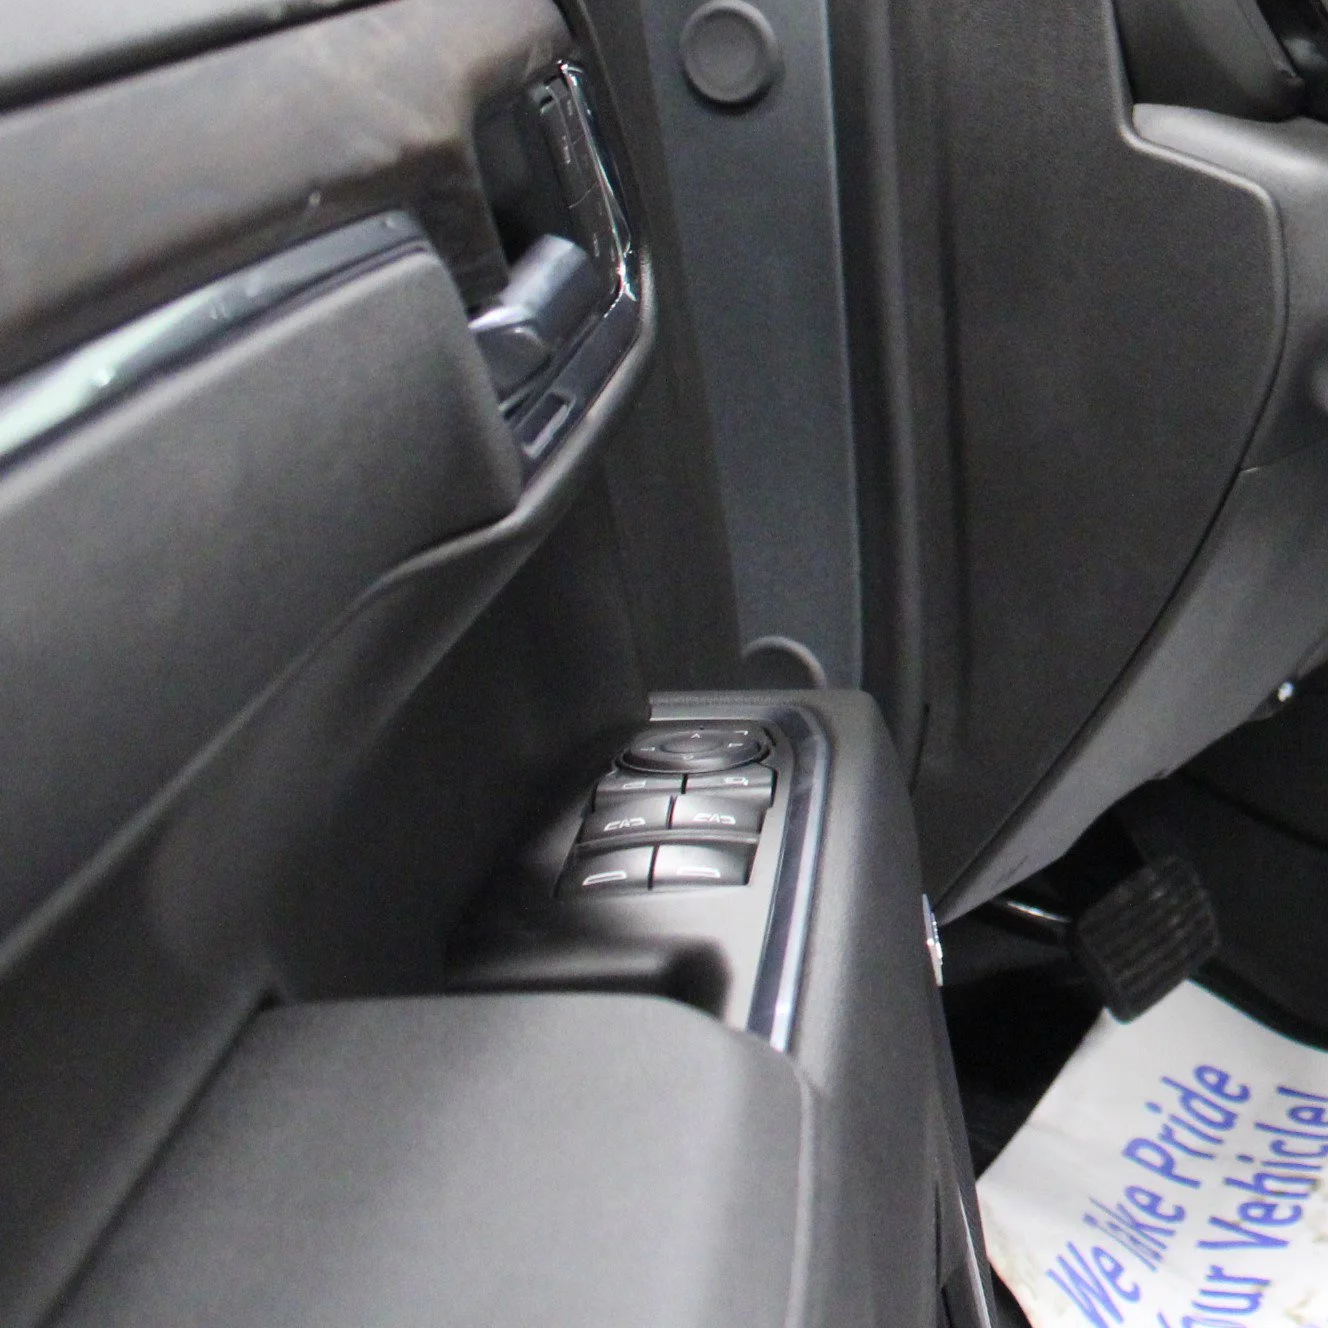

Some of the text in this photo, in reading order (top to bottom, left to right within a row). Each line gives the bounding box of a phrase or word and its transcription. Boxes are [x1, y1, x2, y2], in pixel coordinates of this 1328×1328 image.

[1048, 1240, 1141, 1328] We
[1121, 1065, 1250, 1189] Pride
[1157, 1264, 1271, 1328] our
